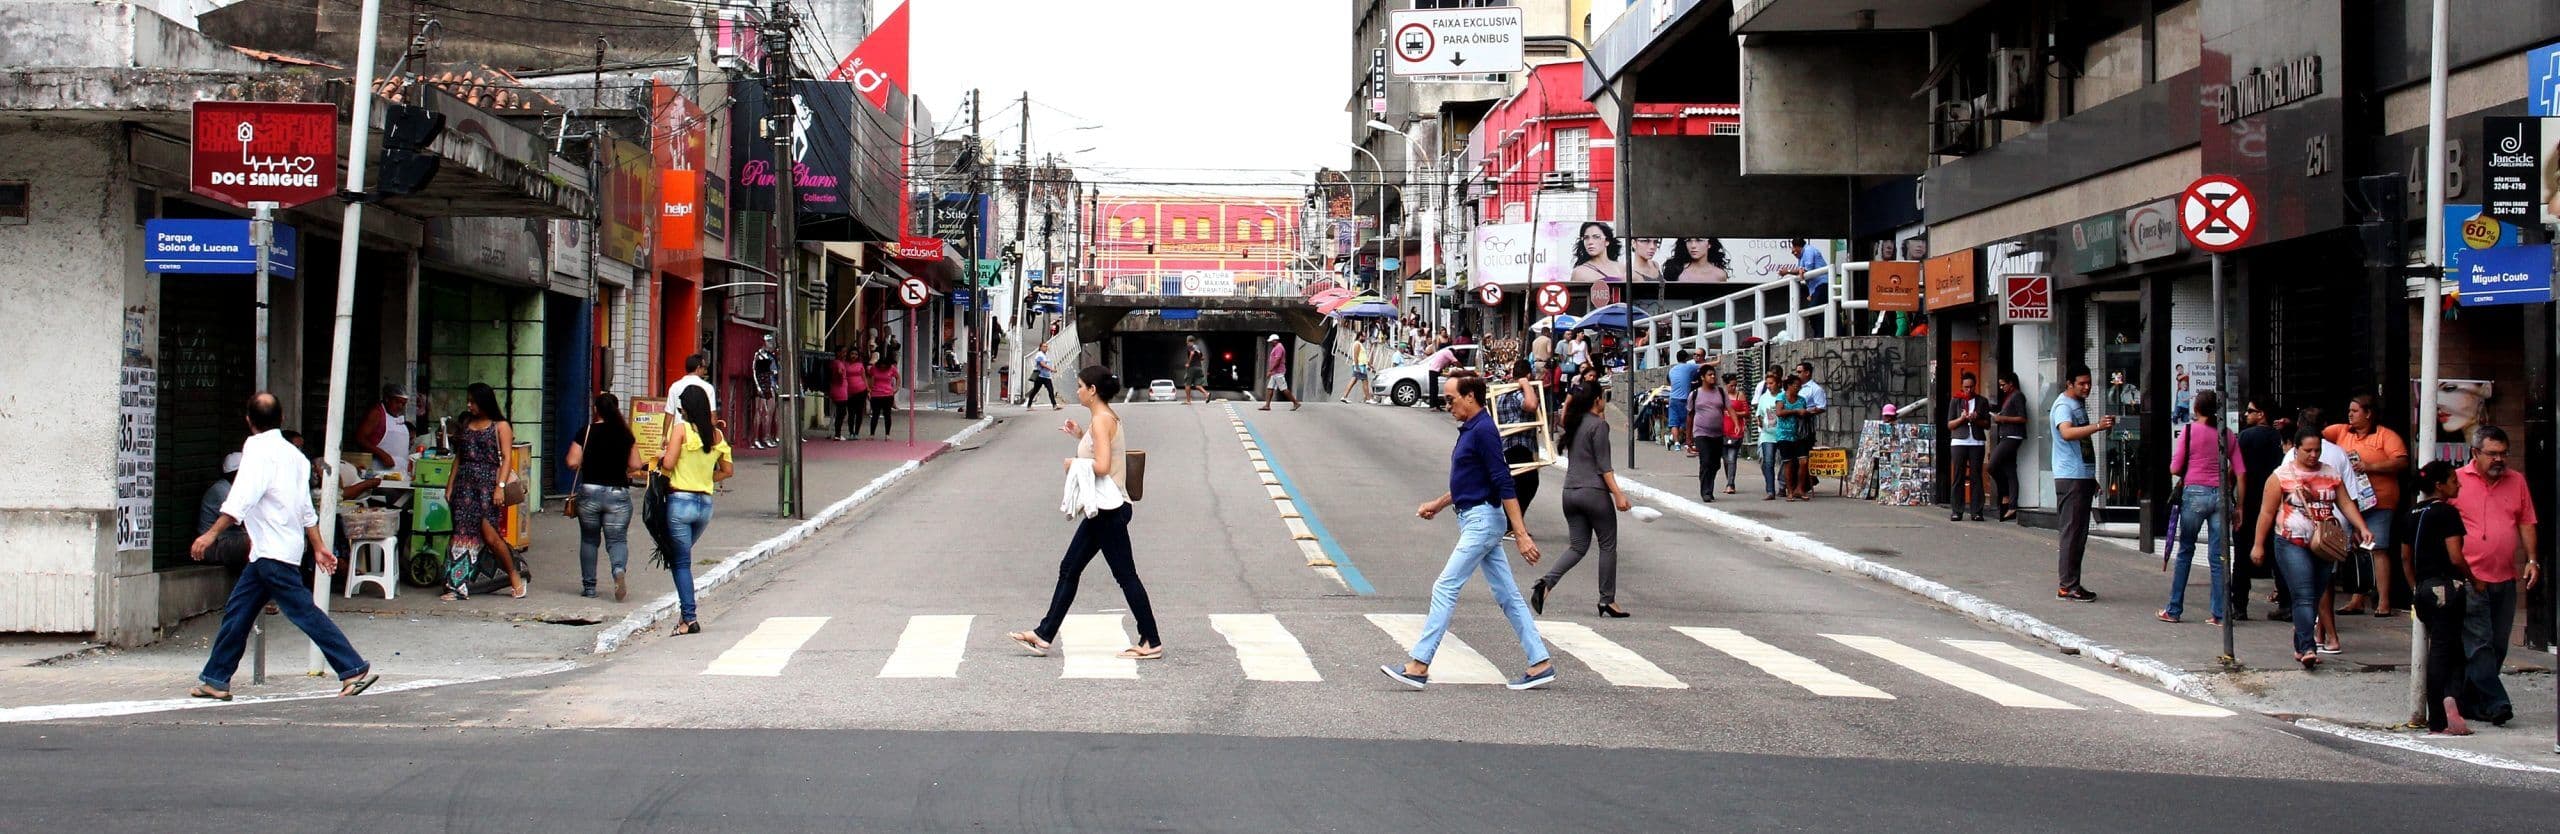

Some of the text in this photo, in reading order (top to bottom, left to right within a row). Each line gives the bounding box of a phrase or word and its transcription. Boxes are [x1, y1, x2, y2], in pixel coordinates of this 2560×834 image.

[1433, 17, 1518, 28] FAIXA EXCLUSIVA
[1443, 33, 1509, 44] PARA ÔNIBUS
[2288, 55, 2317, 102] MAR
[2306, 133, 2328, 177] 251
[211, 171, 319, 187] DOE SANGUE!
[803, 193, 837, 202] Collection
[664, 202, 692, 216] help!
[2465, 223, 2496, 240] 60%
[158, 232, 193, 243] Parque
[158, 243, 239, 253] Solon de Lucena
[900, 247, 939, 258] exclusiva
[2472, 264, 2486, 273] Av.
[2472, 273, 2529, 285] Miguel Couto
[2008, 308, 2049, 318] DINIZ
